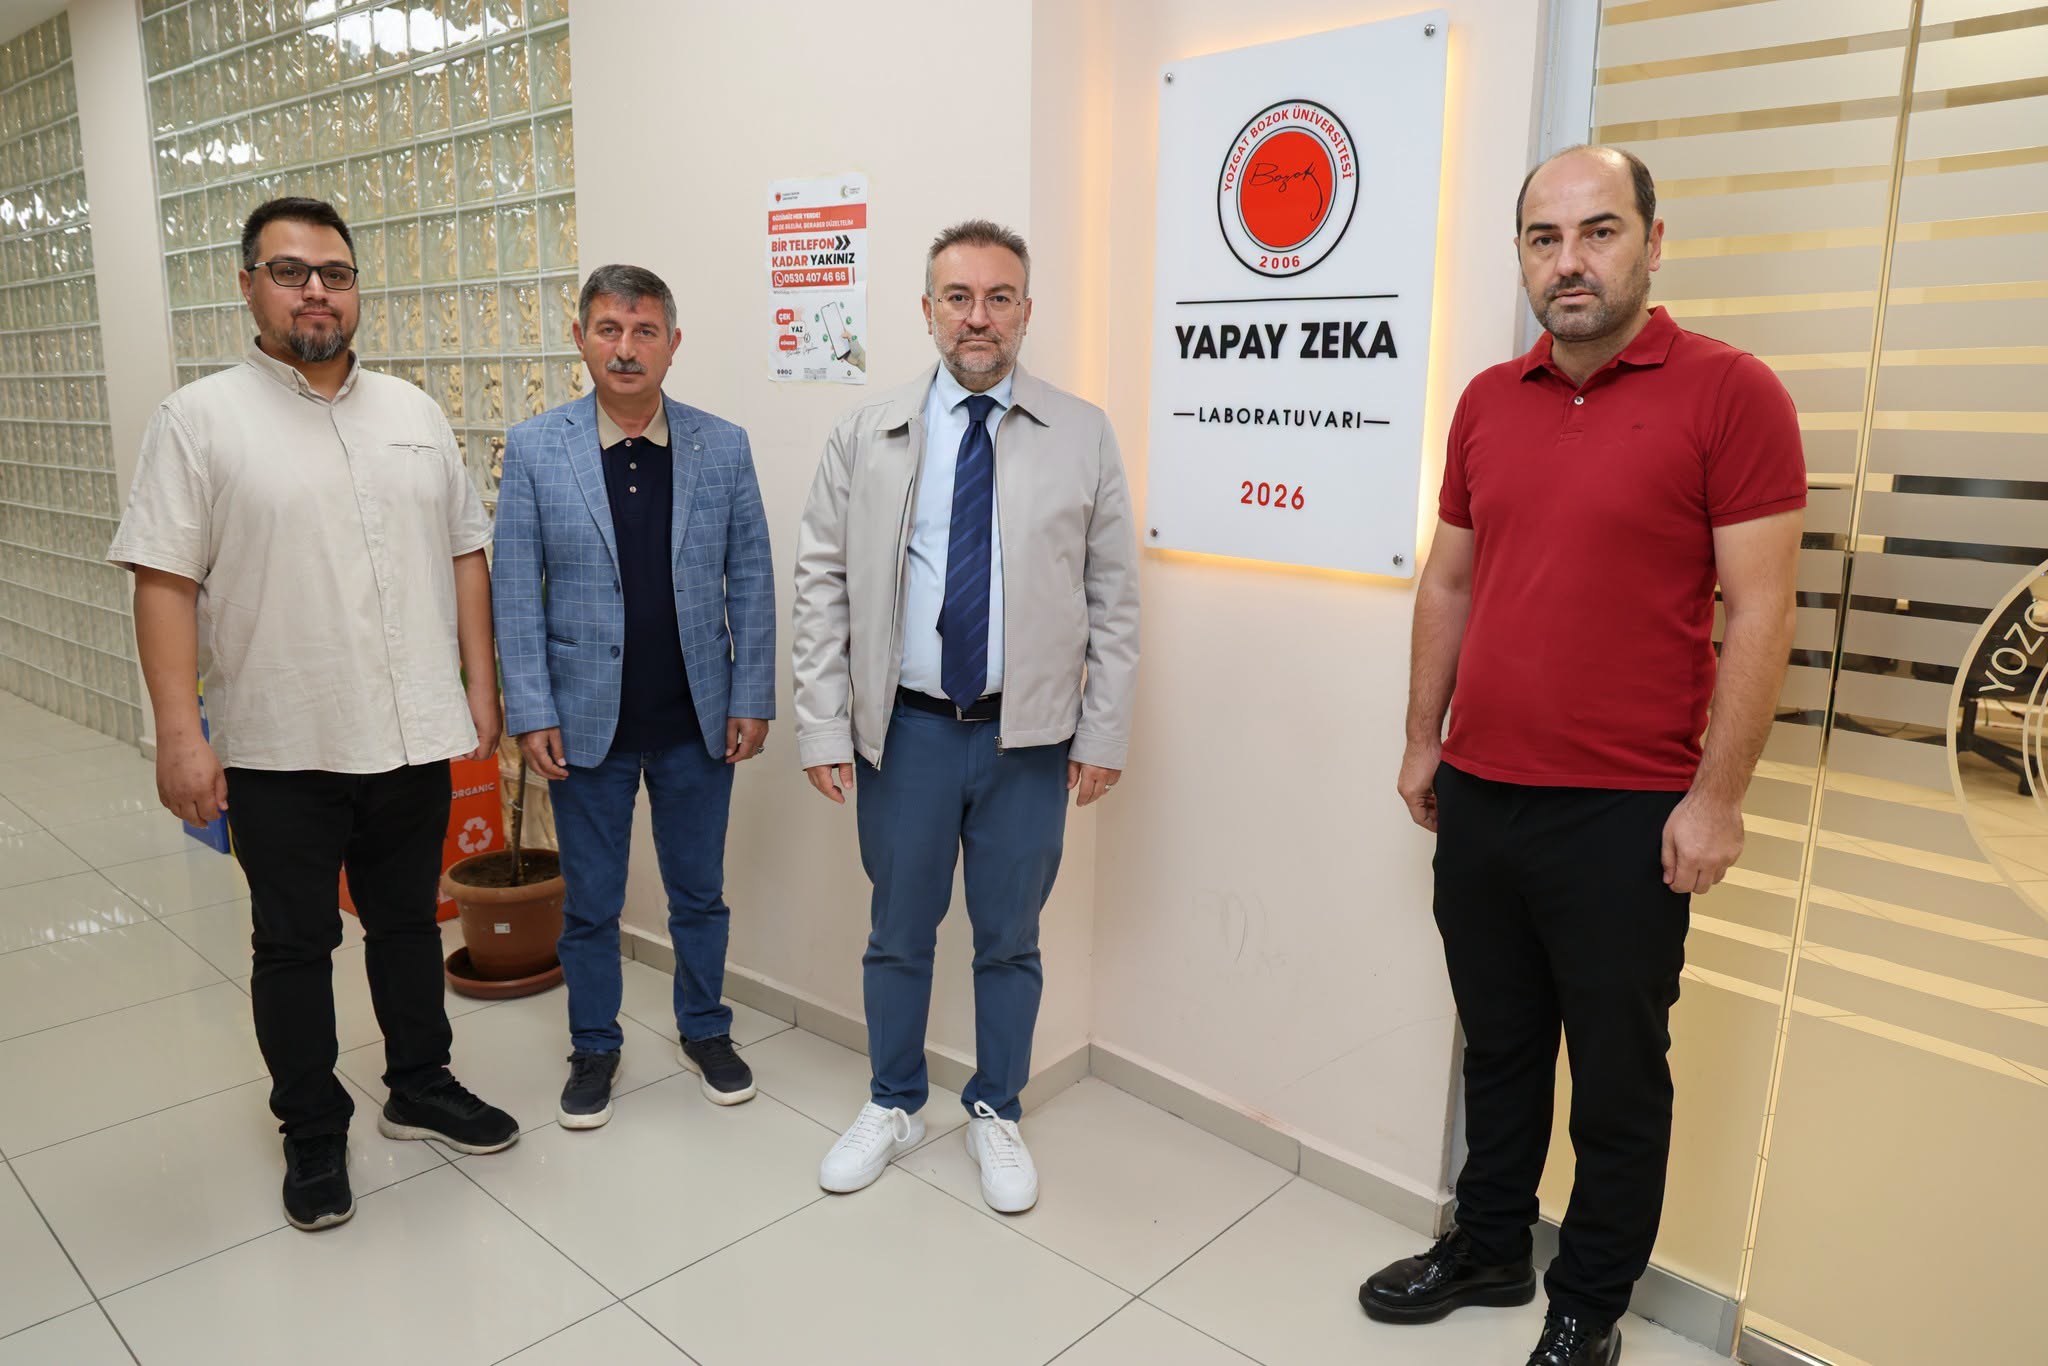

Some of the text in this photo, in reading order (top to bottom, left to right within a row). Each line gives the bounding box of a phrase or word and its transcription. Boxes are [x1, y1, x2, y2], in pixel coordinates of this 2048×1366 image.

[1224, 105, 1355, 192] YOZGAT BOZOK ÜNİVERSİTESİ
[1249, 162, 1323, 221] Bozok
[771, 238, 835, 252] BİR TELEFON
[772, 252, 855, 267] KADAR YAKINIZ
[1259, 255, 1300, 269] 2006
[784, 271, 846, 283] 0530 407 46 66
[778, 313, 791, 322] ÇEK
[1175, 321, 1398, 359] YAPAY ZEKA
[1199, 407, 1361, 429] LABORATUVARI
[1241, 480, 1305, 510] 2026
